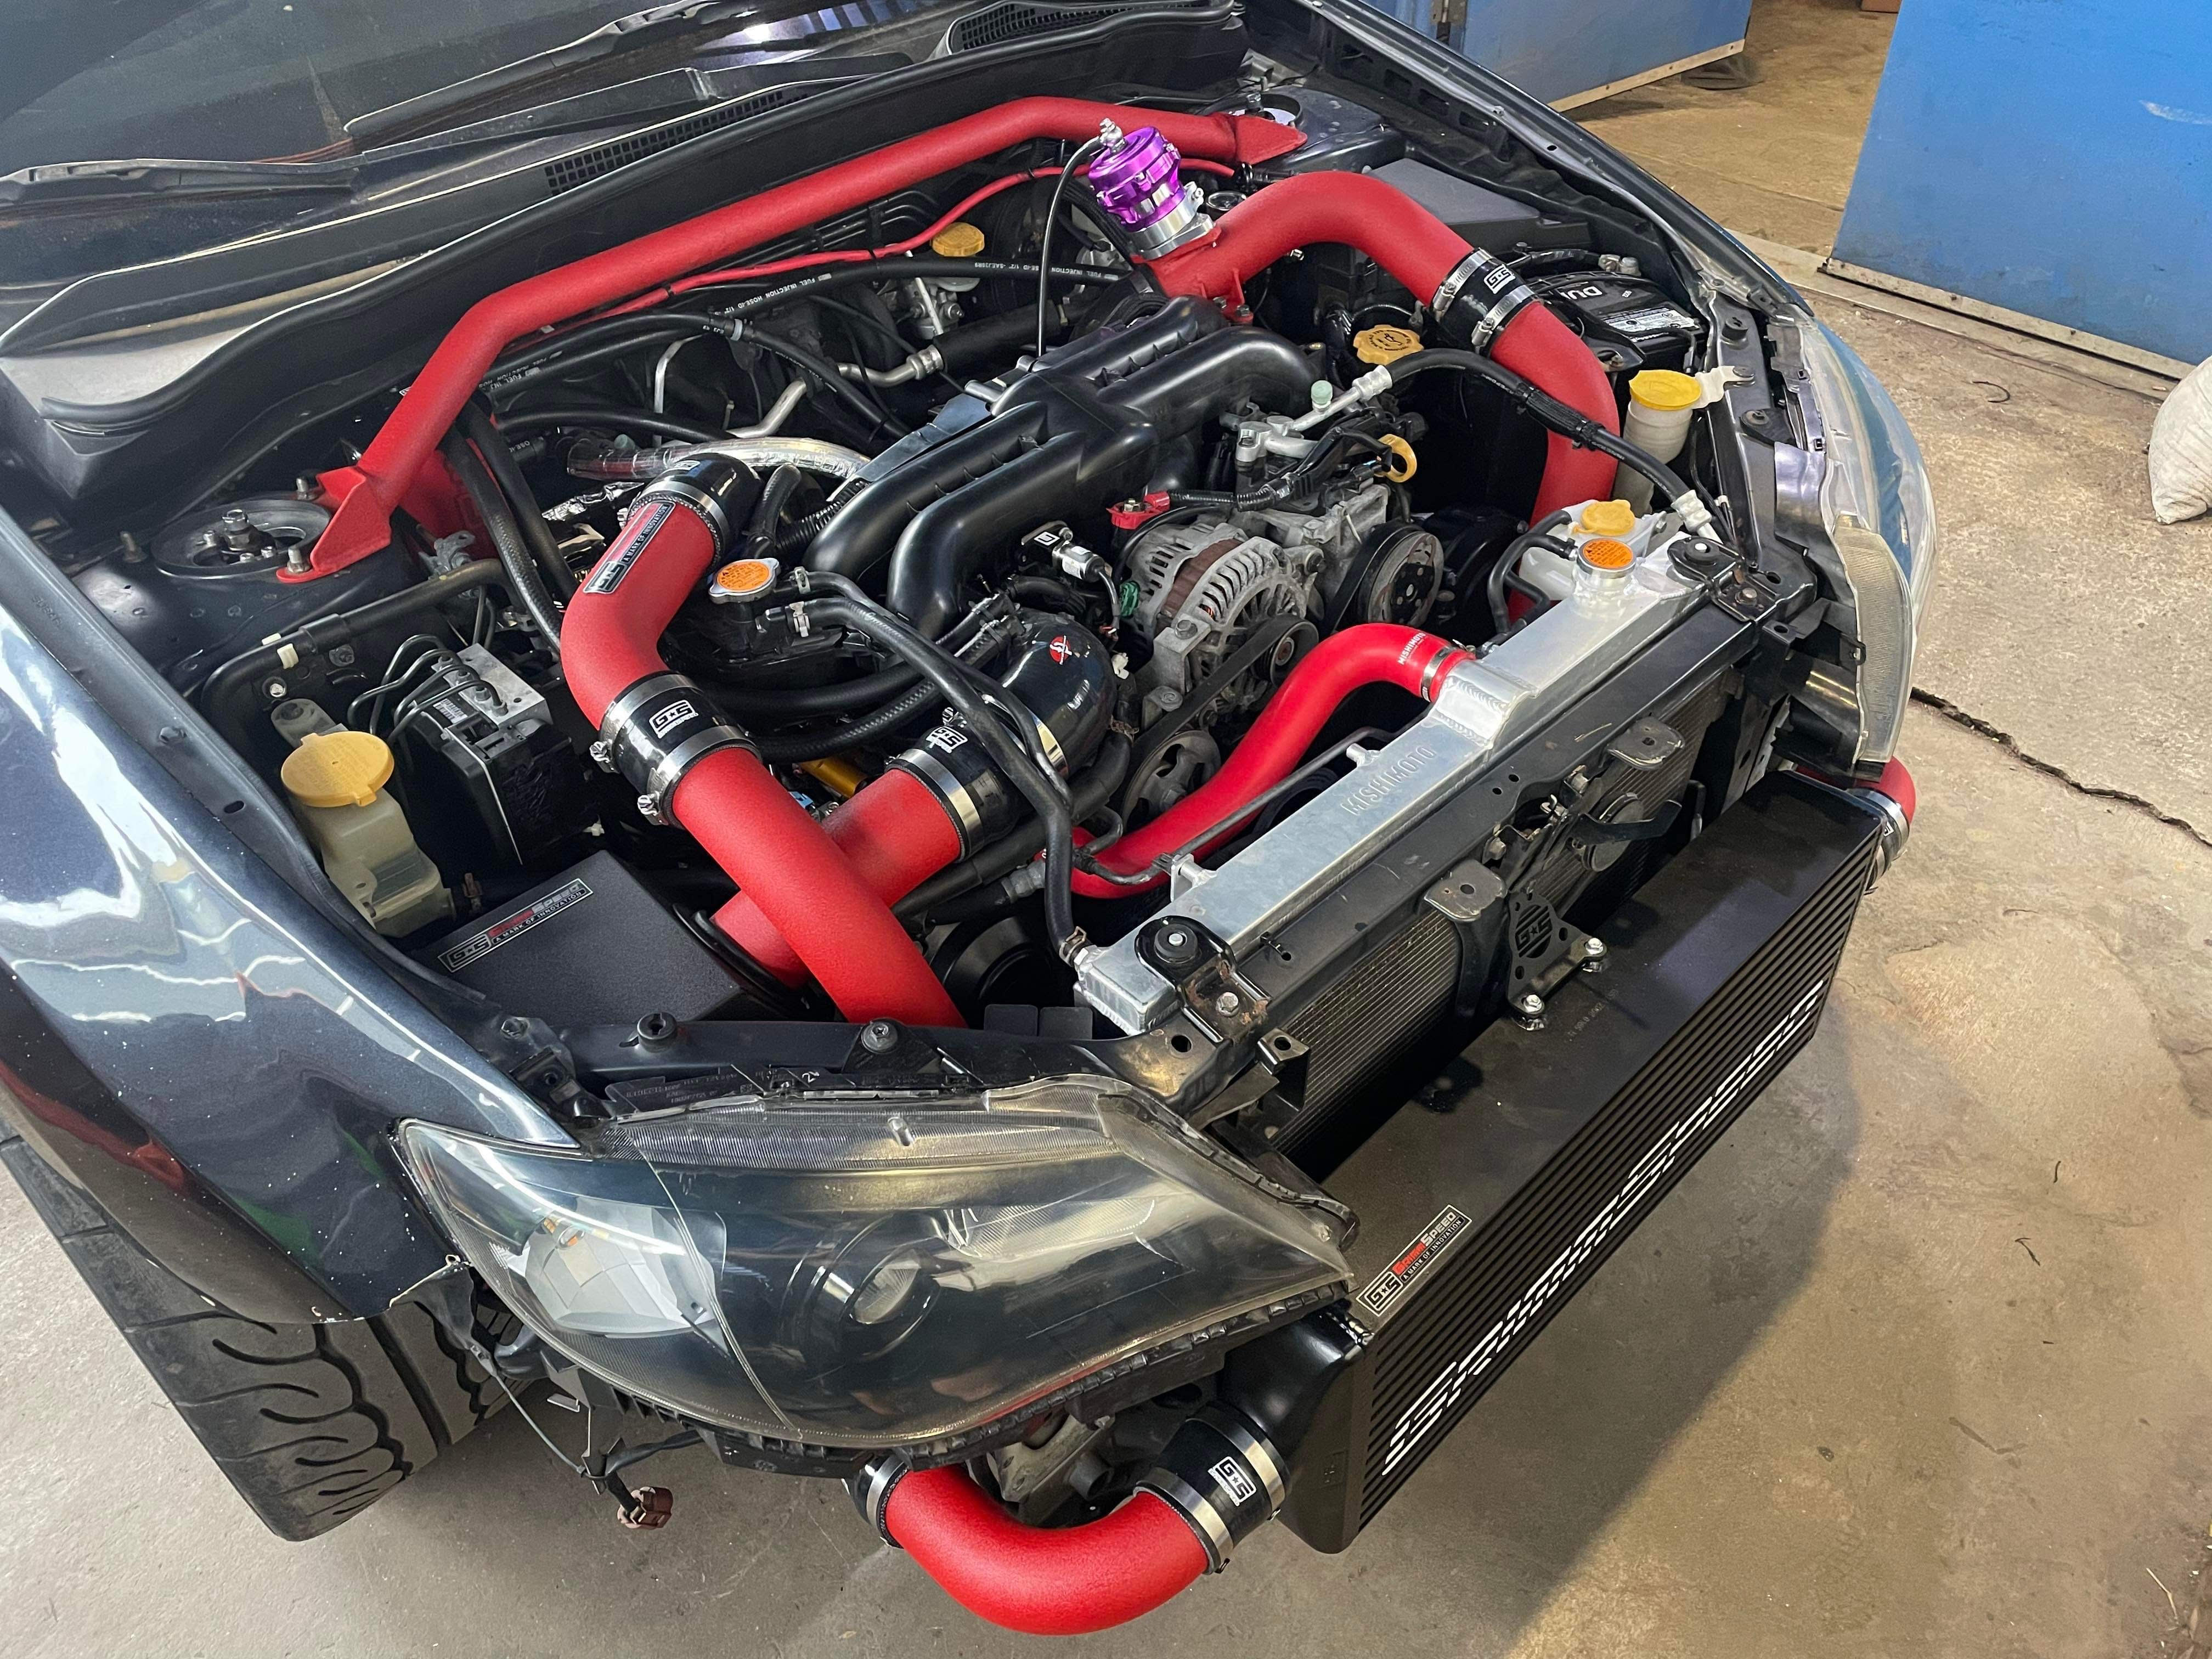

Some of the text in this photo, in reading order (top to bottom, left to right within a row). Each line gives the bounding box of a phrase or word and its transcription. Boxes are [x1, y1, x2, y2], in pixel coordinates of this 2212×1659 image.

[799, 277, 816, 286] FUEL
[1051, 267, 1083, 275] INJECTION
[765, 283, 798, 299] INJECTION
[504, 373, 522, 383] FUEL
[627, 541, 641, 558] MARK
[639, 533, 646, 542] OF
[644, 505, 668, 535] INNOVATION
[1397, 631, 1426, 665] MISHIMOTO
[1340, 745, 1438, 816] MISHIMOTO
[503, 923, 523, 938] MARK
[525, 917, 535, 925] OF
[537, 891, 582, 918] INNOVATION
[1408, 1259, 1424, 1275] MARK
[1423, 1252, 1431, 1260] OF
[1430, 1220, 1462, 1252] INNOVATION
